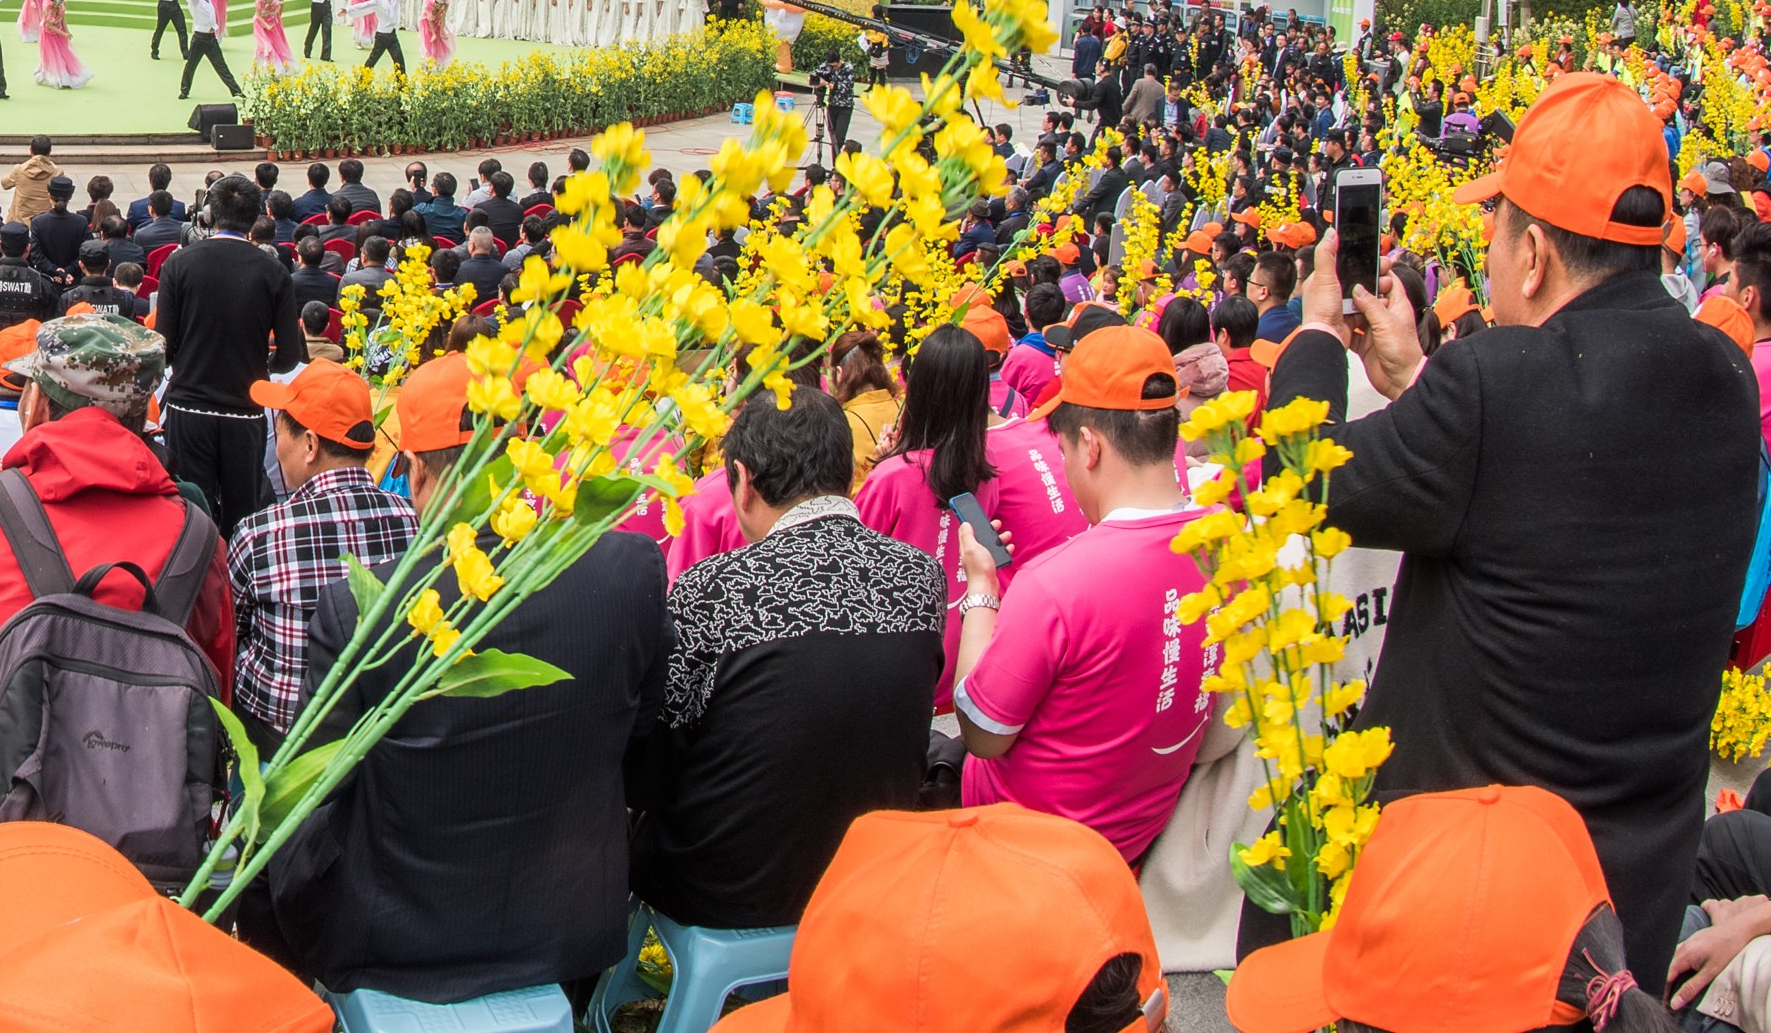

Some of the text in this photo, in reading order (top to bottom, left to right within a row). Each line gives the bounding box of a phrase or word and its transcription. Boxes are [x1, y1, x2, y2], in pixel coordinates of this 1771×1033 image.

[1028, 449, 1065, 514] 品味慢生活
[1155, 588, 1182, 713] 品味慢生活
